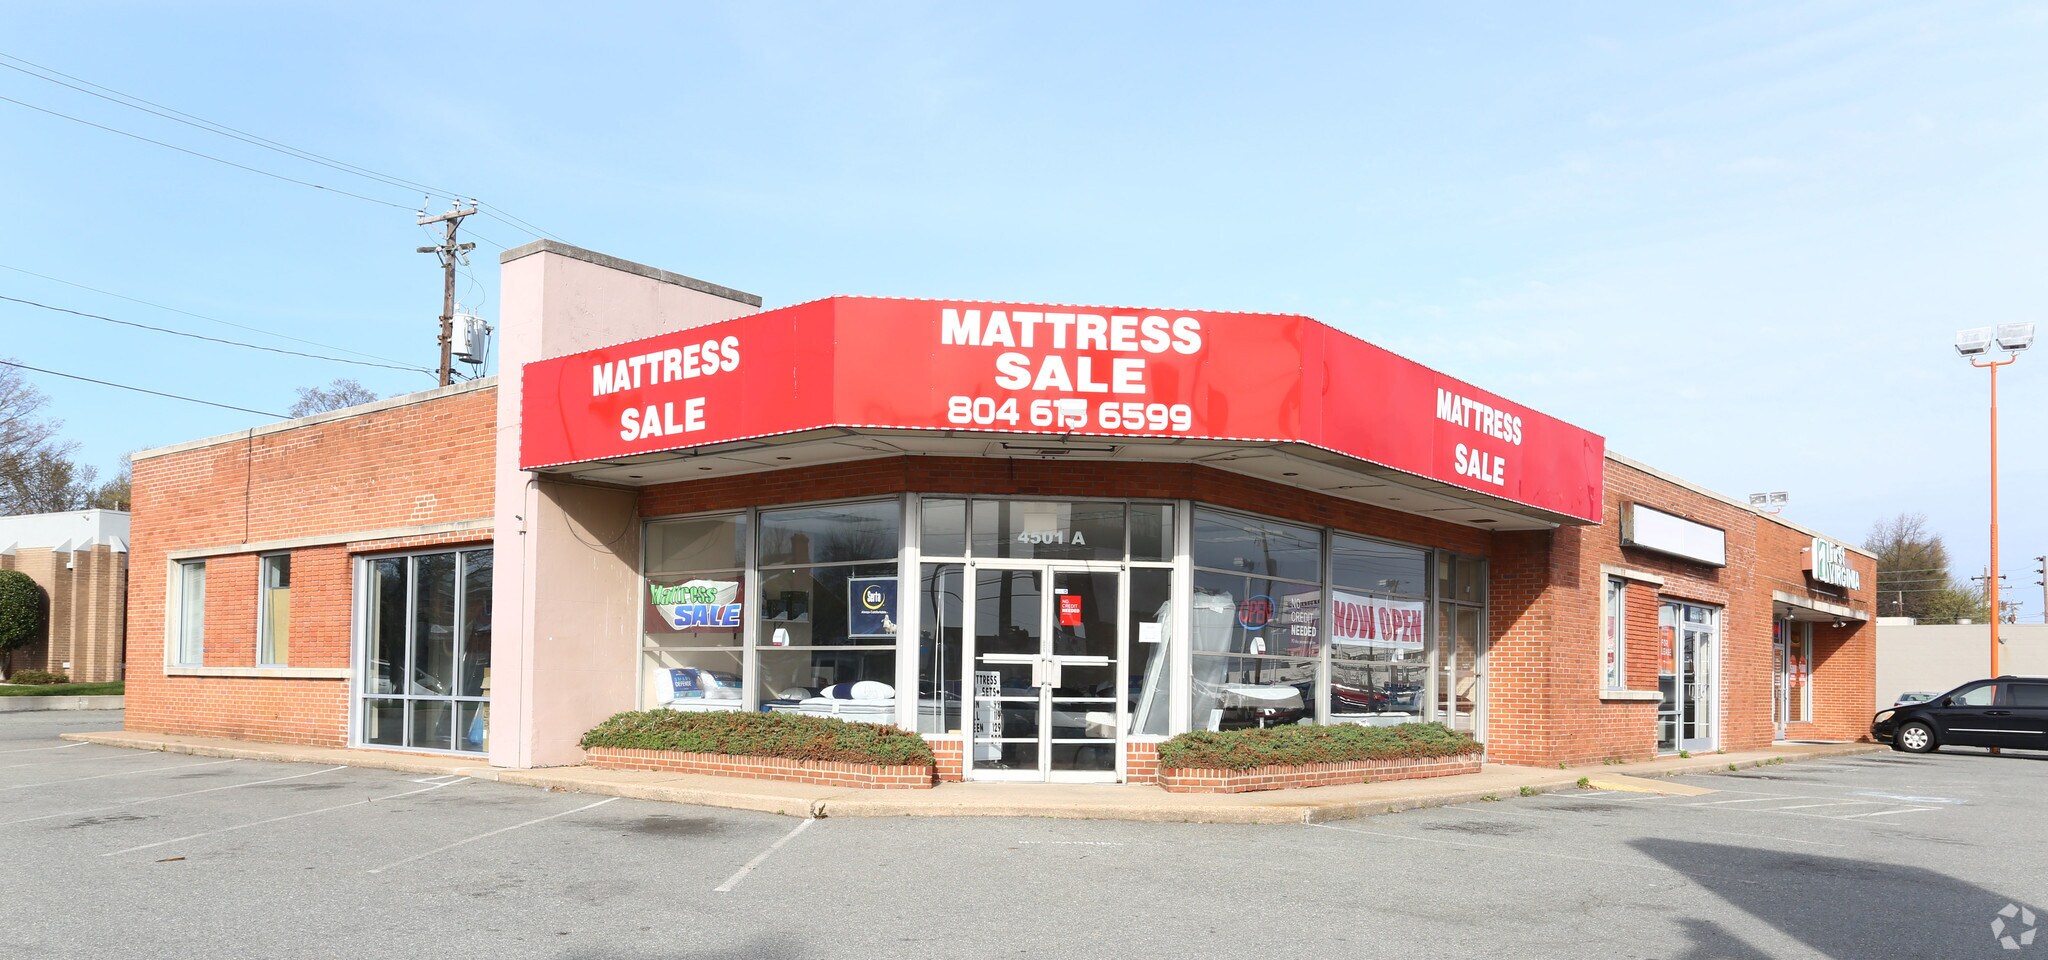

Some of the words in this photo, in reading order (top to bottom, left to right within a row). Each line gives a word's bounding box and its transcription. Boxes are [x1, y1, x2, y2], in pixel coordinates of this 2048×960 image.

[941, 308, 1202, 355] MATTRESS
[593, 335, 740, 397] MATTRESS
[994, 352, 1146, 394] SALE
[620, 396, 706, 442] SALE
[947, 395, 1020, 426] 804
[1098, 401, 1192, 432] 6599
[1436, 387, 1523, 446] MATTRESS
[1454, 442, 1505, 487] SALE
[1018, 530, 1063, 545] 4501
[1071, 530, 1086, 545] A
[1827, 561, 1860, 591] VIRGINIA
[650, 584, 718, 605] Mattress
[867, 590, 882, 603] Serta
[1291, 597, 1302, 609] NO
[674, 602, 742, 627] SALE
[1239, 599, 1273, 625] OPEN
[1290, 611, 1315, 624] CREDIT
[1333, 600, 1377, 640] NOW
[1378, 606, 1422, 643] OPEN
[1290, 624, 1318, 637] NEEDED
